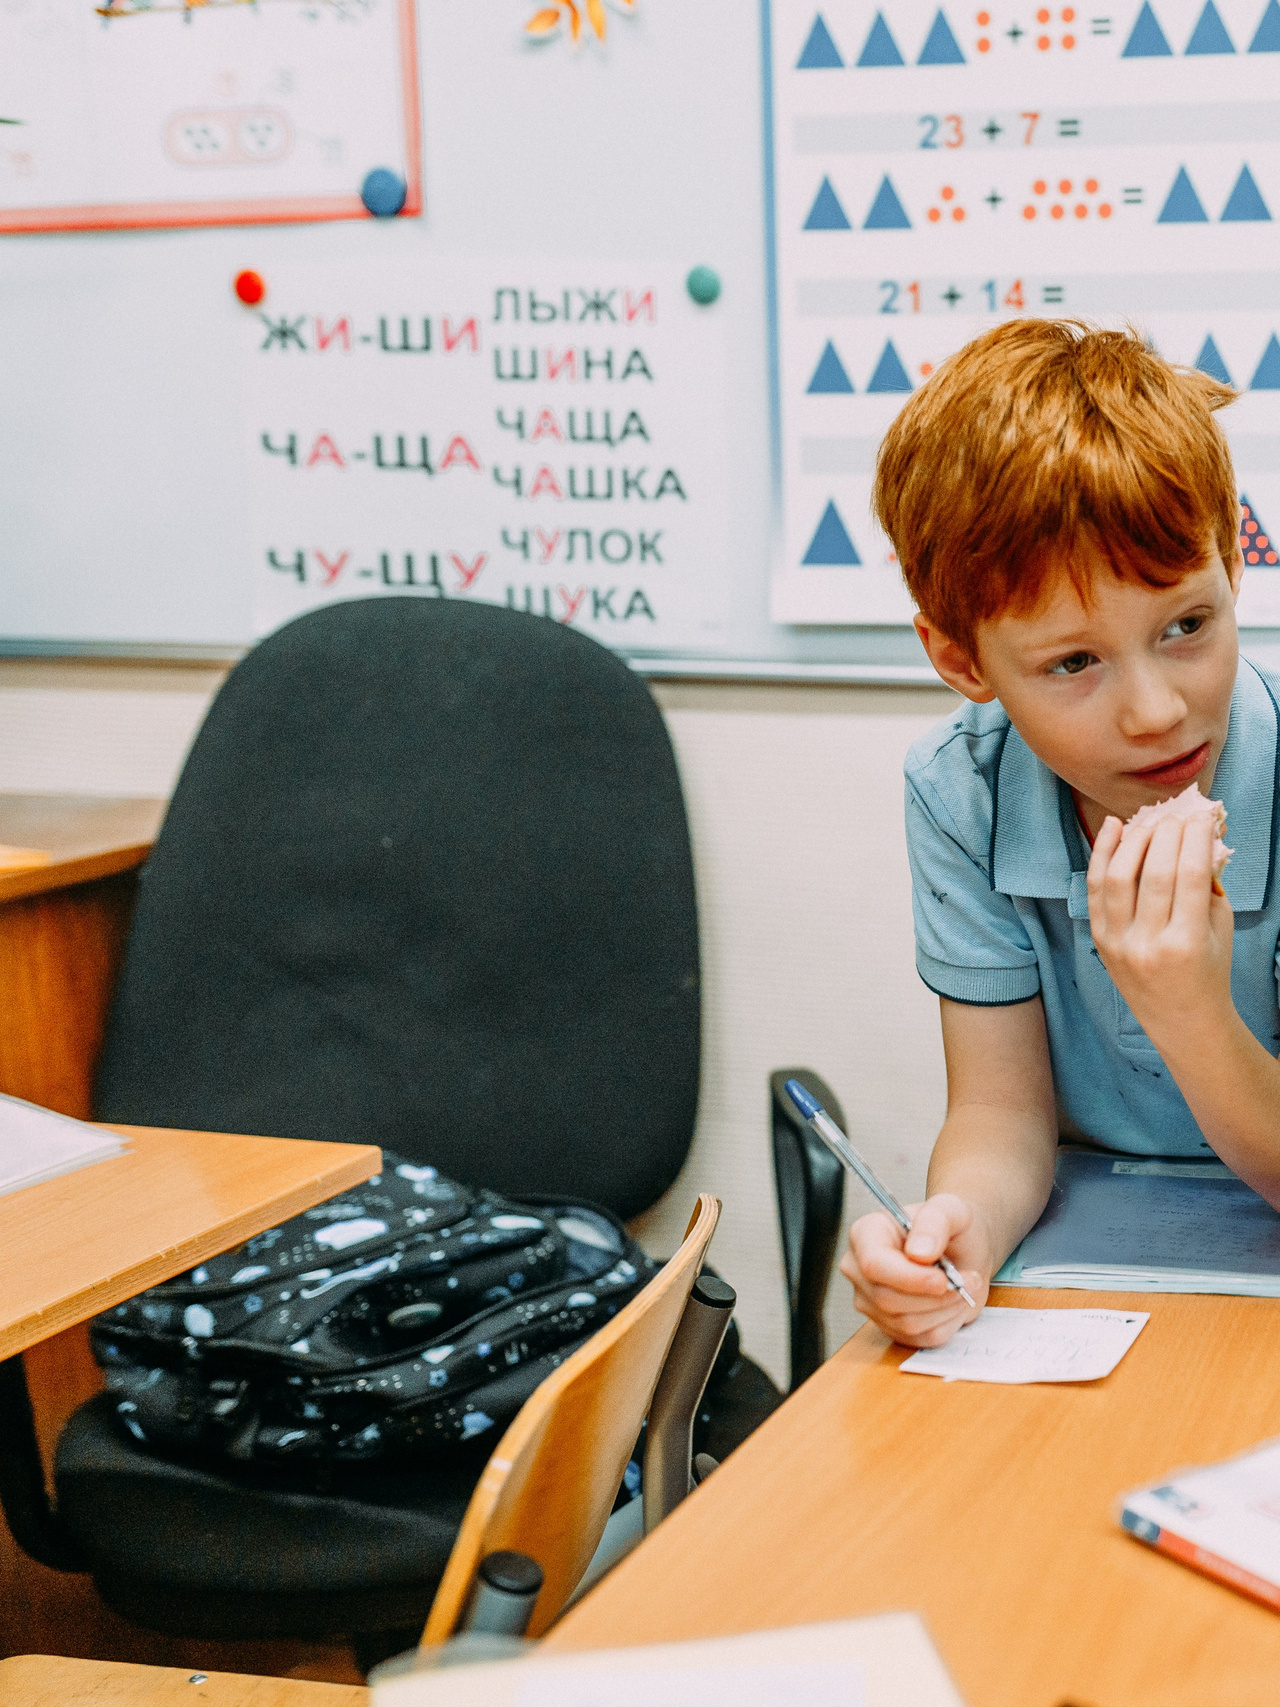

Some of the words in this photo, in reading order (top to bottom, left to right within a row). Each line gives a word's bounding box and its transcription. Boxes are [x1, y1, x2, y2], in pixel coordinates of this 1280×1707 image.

[917, 113, 966, 150] 23
[1019, 110, 1041, 147] 7
[492, 287, 656, 324] ЛЫЖИ
[878, 279, 921, 315] 21
[980, 277, 1027, 314] 14
[259, 314, 479, 353] ЖИ-ШИ
[493, 346, 655, 382] ШИНА
[495, 407, 652, 448] ЧАЩА
[260, 431, 482, 478] ЧА-ЩА
[492, 465, 689, 502] ЧАШКА
[501, 527, 665, 565] ЧУЛОК
[266, 547, 487, 598] ЧУ-ЩУ
